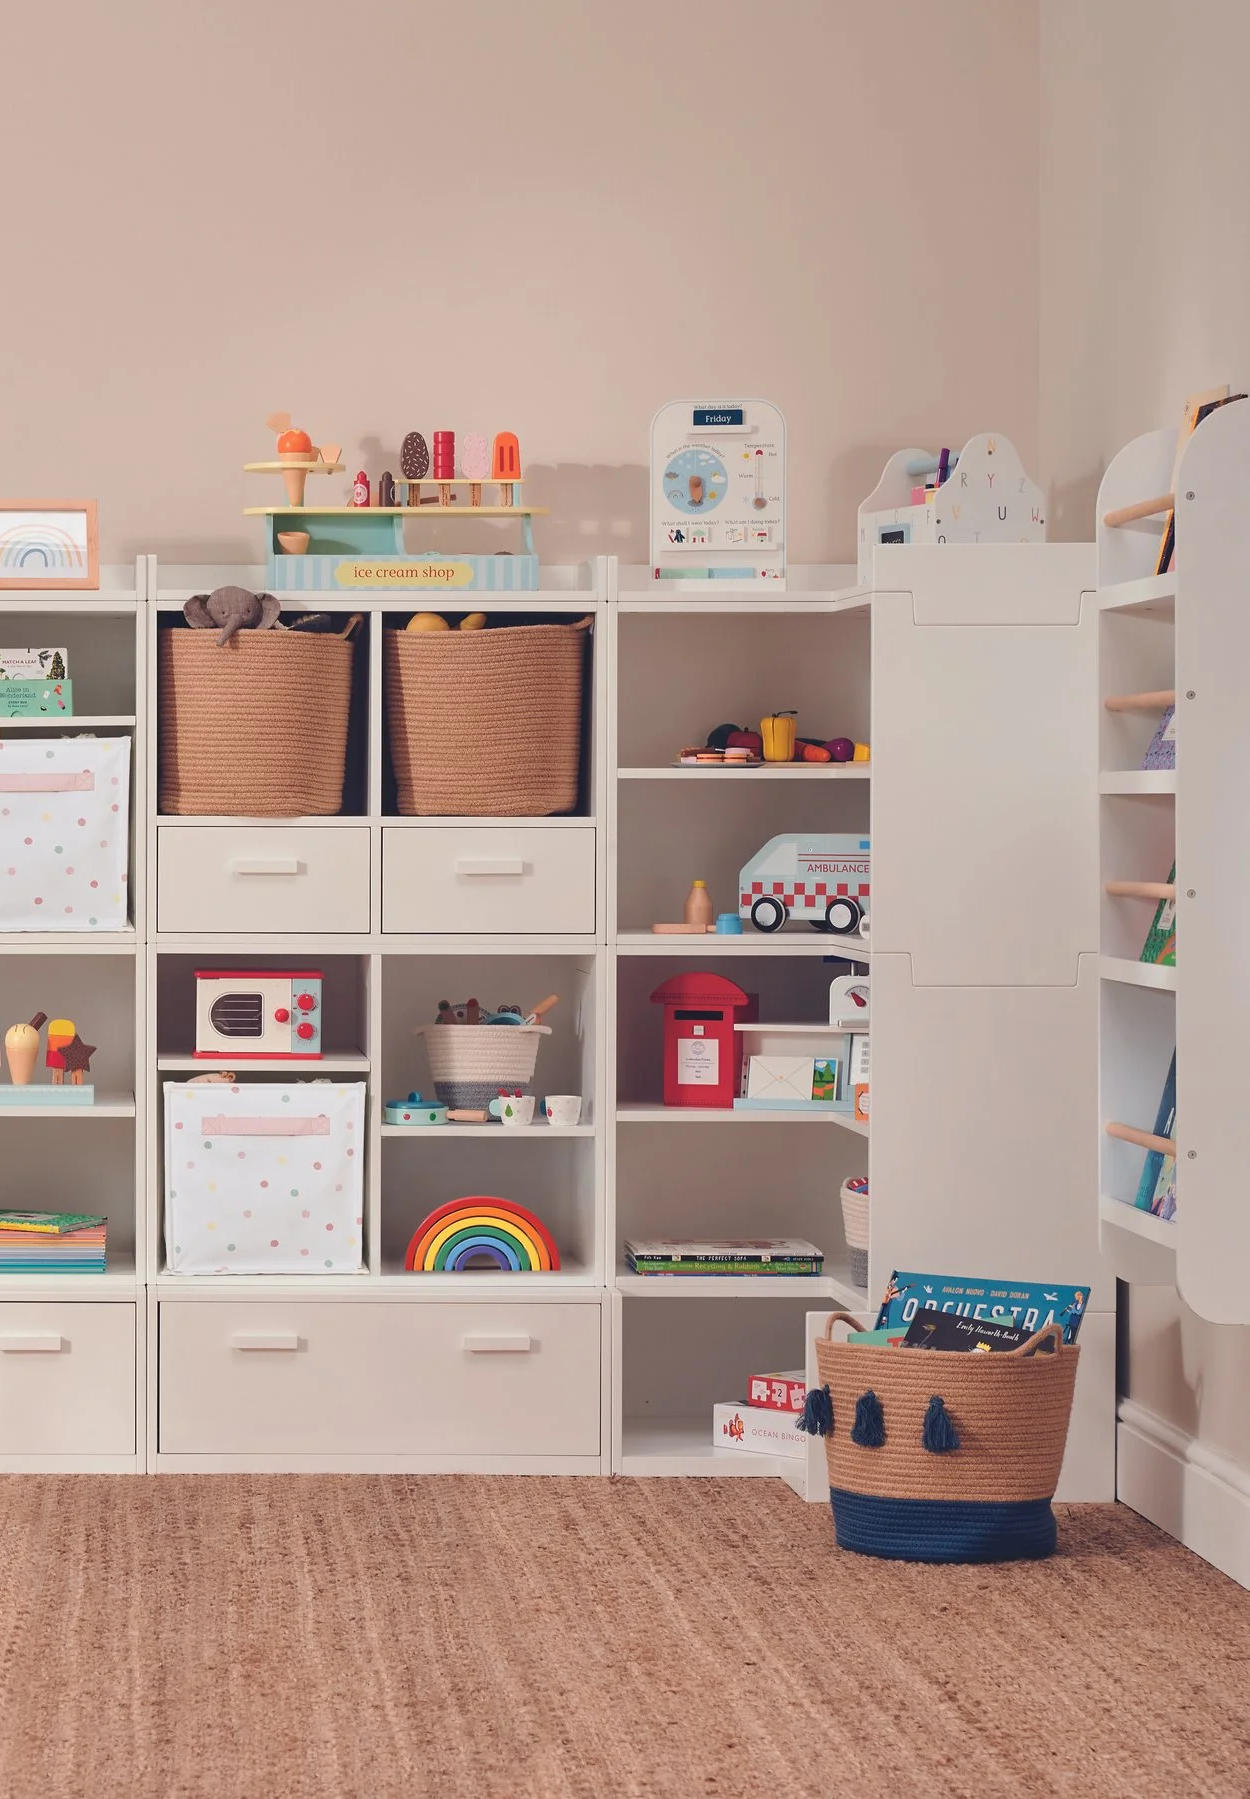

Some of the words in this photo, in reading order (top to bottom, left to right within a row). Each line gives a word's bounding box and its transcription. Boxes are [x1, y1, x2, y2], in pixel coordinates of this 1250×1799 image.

[705, 415, 732, 424] Friday
[987, 439, 996, 453] N
[961, 473, 968, 488] R
[987, 474, 995, 488] Y
[952, 506, 960, 520] V
[998, 506, 1007, 520] U
[1032, 508, 1039, 522] W
[354, 566, 373, 578] ice
[376, 568, 418, 578] cream
[422, 566, 455, 581] shop
[807, 864, 869, 873] AMBULANCE
[694, 1262, 725, 1270] Recycling
[942, 1286, 963, 1294] AVALON
[965, 1288, 985, 1296] NUOVO
[990, 1290, 1007, 1298] DAVID
[956, 1321, 974, 1335] Emily
[752, 1429, 778, 1438] OCEAN
[782, 1433, 806, 1442] BINGO
